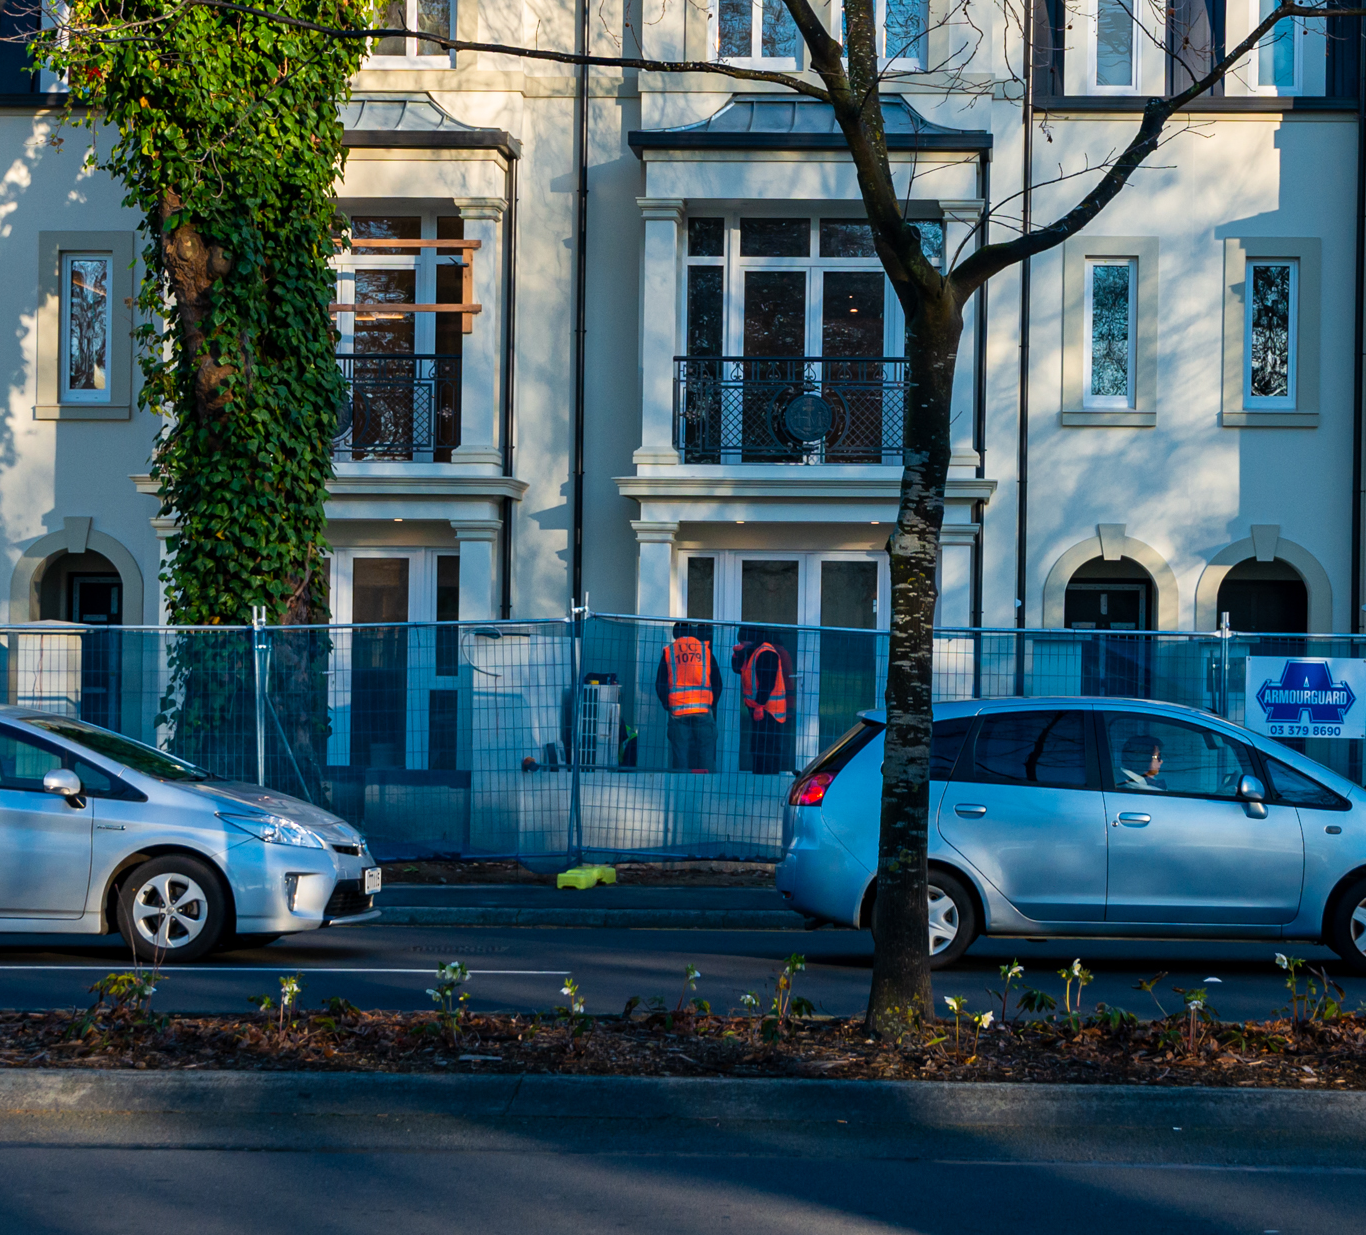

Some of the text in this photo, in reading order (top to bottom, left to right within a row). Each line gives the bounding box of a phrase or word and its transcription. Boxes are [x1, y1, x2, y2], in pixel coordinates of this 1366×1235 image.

[678, 643, 697, 653] UC
[675, 653, 702, 664] 1079
[1264, 689, 1348, 704] ARMOURGUARD
[1270, 725, 1341, 736] 03 379 8690
